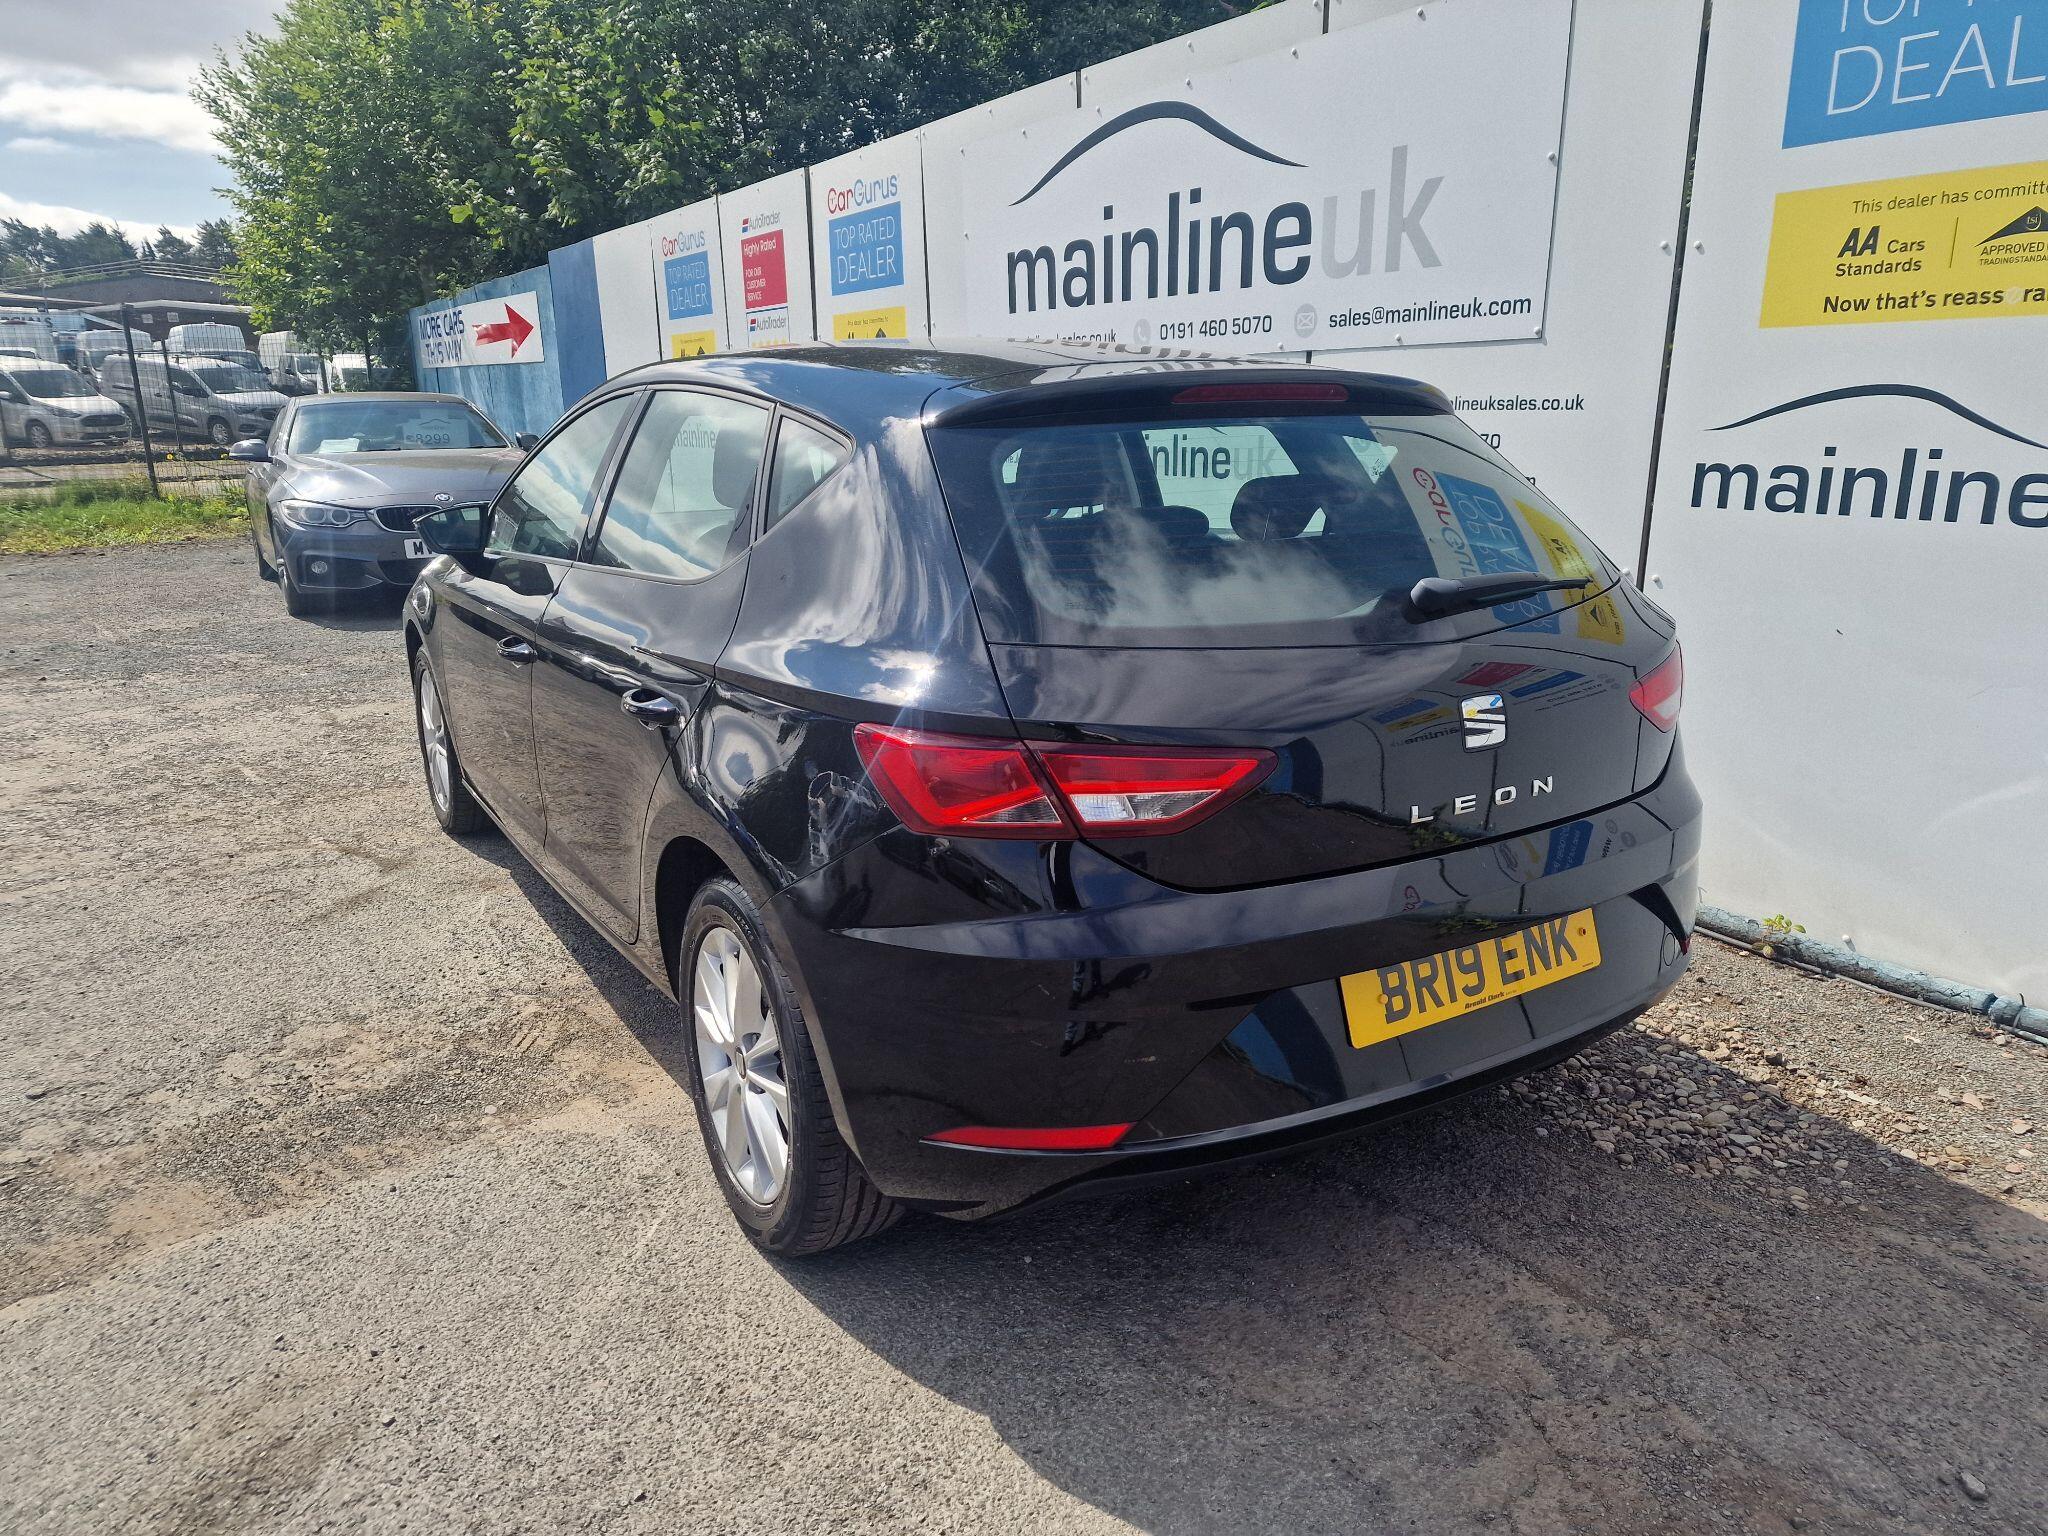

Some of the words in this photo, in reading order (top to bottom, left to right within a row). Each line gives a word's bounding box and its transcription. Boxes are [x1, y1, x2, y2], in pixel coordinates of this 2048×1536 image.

[828, 174, 898, 214] CarGurus
[1852, 199, 1882, 214] This
[1887, 193, 1937, 211] dealer
[1941, 190, 1969, 206] has
[749, 211, 780, 230] AutoTrader
[835, 225, 855, 249] TOP
[858, 216, 895, 244] RATED
[1007, 144, 1445, 314] mainlineuk
[662, 230, 705, 256] CarGurus
[744, 241, 759, 257] Highly
[760, 237, 776, 251] Rated
[1837, 225, 1881, 258] AA
[1887, 238, 1926, 254] Cars
[1980, 241, 2045, 257] APPROVED
[668, 266, 680, 285] TOP
[682, 261, 705, 281] RATED
[837, 245, 896, 284] DEALER
[1835, 258, 1922, 278] Standards
[1979, 254, 2048, 266] TRADINGSTANDA
[671, 282, 709, 311] DEALER
[1823, 296, 1871, 314] Now
[1876, 290, 1937, 311] that's
[420, 315, 441, 340] MORE
[444, 310, 465, 336] CARS
[756, 316, 787, 331] AutoTrader
[1329, 297, 1531, 328] sales@mainlineuk.com
[1160, 322, 1193, 340] 0191
[1199, 318, 1227, 337] 460
[1232, 314, 1272, 335] 5070
[426, 341, 444, 364] THIS
[445, 339, 462, 363] WAY
[1451, 394, 1584, 410] lineuksales.co.uk
[1690, 446, 2048, 528] mainline
[1410, 775, 1554, 824] LEON
[1376, 943, 1486, 1025] BR19
[1494, 915, 1578, 986] ENK
[1465, 997, 1487, 1010] Arnold
